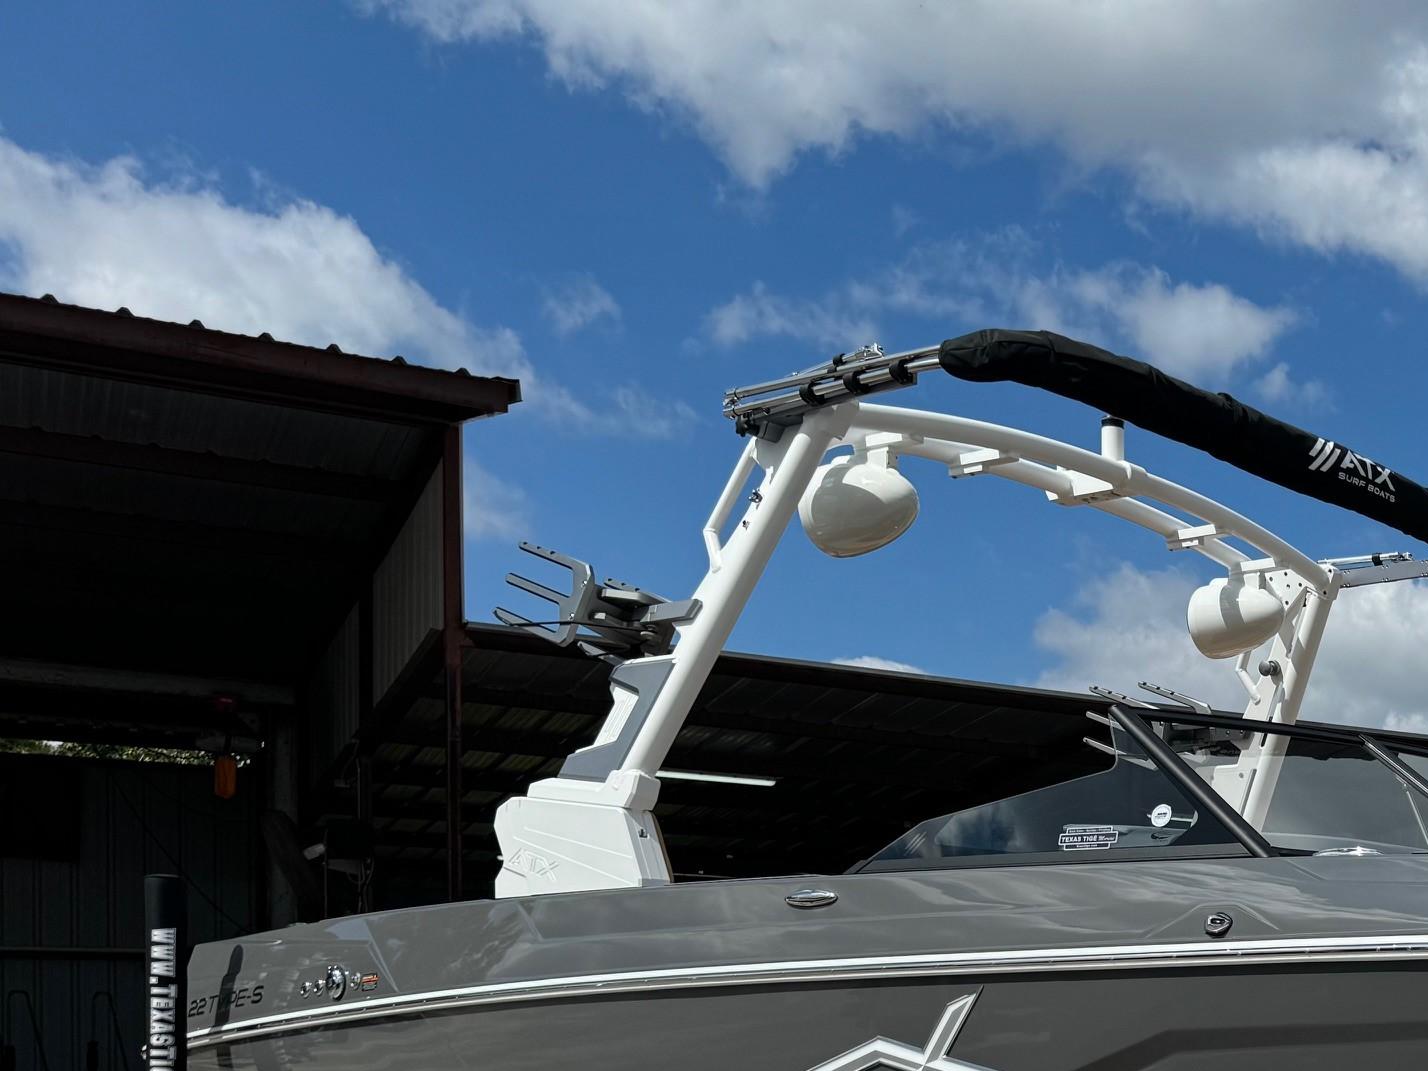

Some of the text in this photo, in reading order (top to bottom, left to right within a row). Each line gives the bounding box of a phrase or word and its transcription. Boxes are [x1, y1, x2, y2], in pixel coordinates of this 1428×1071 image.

[1340, 450, 1396, 491] ATX
[1338, 472, 1395, 502] SURF BOATS
[509, 848, 560, 880] ATX
[188, 985, 264, 1017] 22 TPE-S
